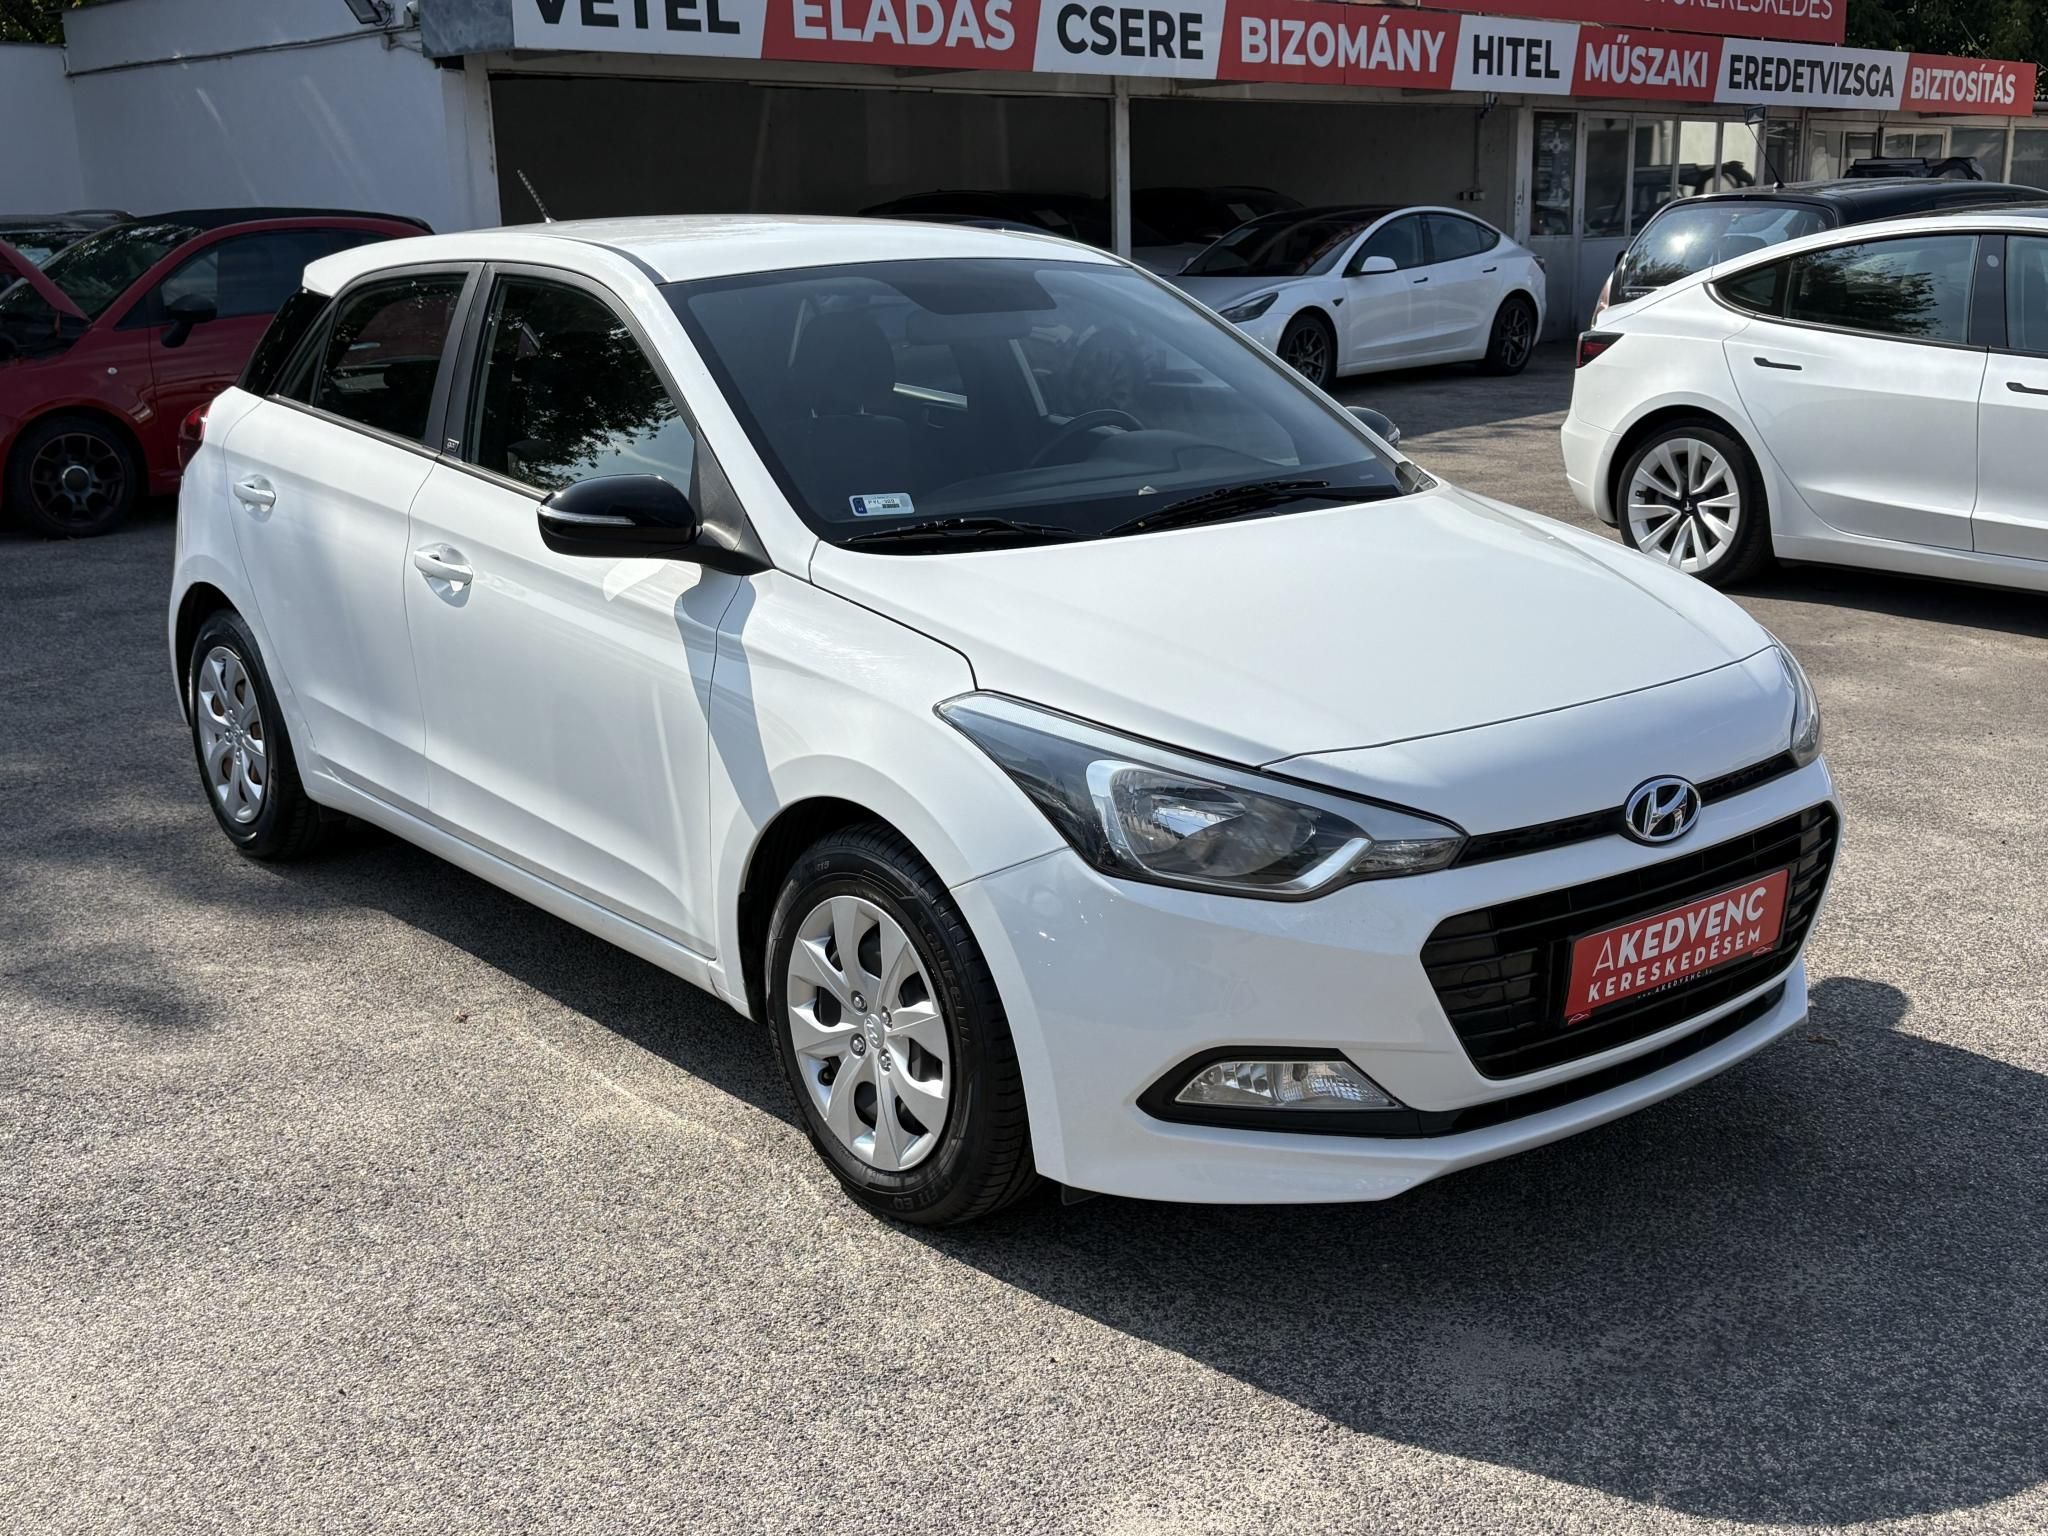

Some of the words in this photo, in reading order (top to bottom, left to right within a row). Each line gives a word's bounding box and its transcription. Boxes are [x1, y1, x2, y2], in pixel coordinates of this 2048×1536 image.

[1056, 3, 1205, 60] CSERE
[1240, 15, 1446, 73] BIZOMÁNY
[1472, 34, 1560, 79] HITEL
[1585, 34, 1708, 88] MŰSZAKI
[1728, 54, 1895, 98] EREDETVIZSGA
[1910, 63, 2016, 105] BIZTOSÍTÁS
[1588, 926, 1761, 1002] KERESKEDÉSEM
